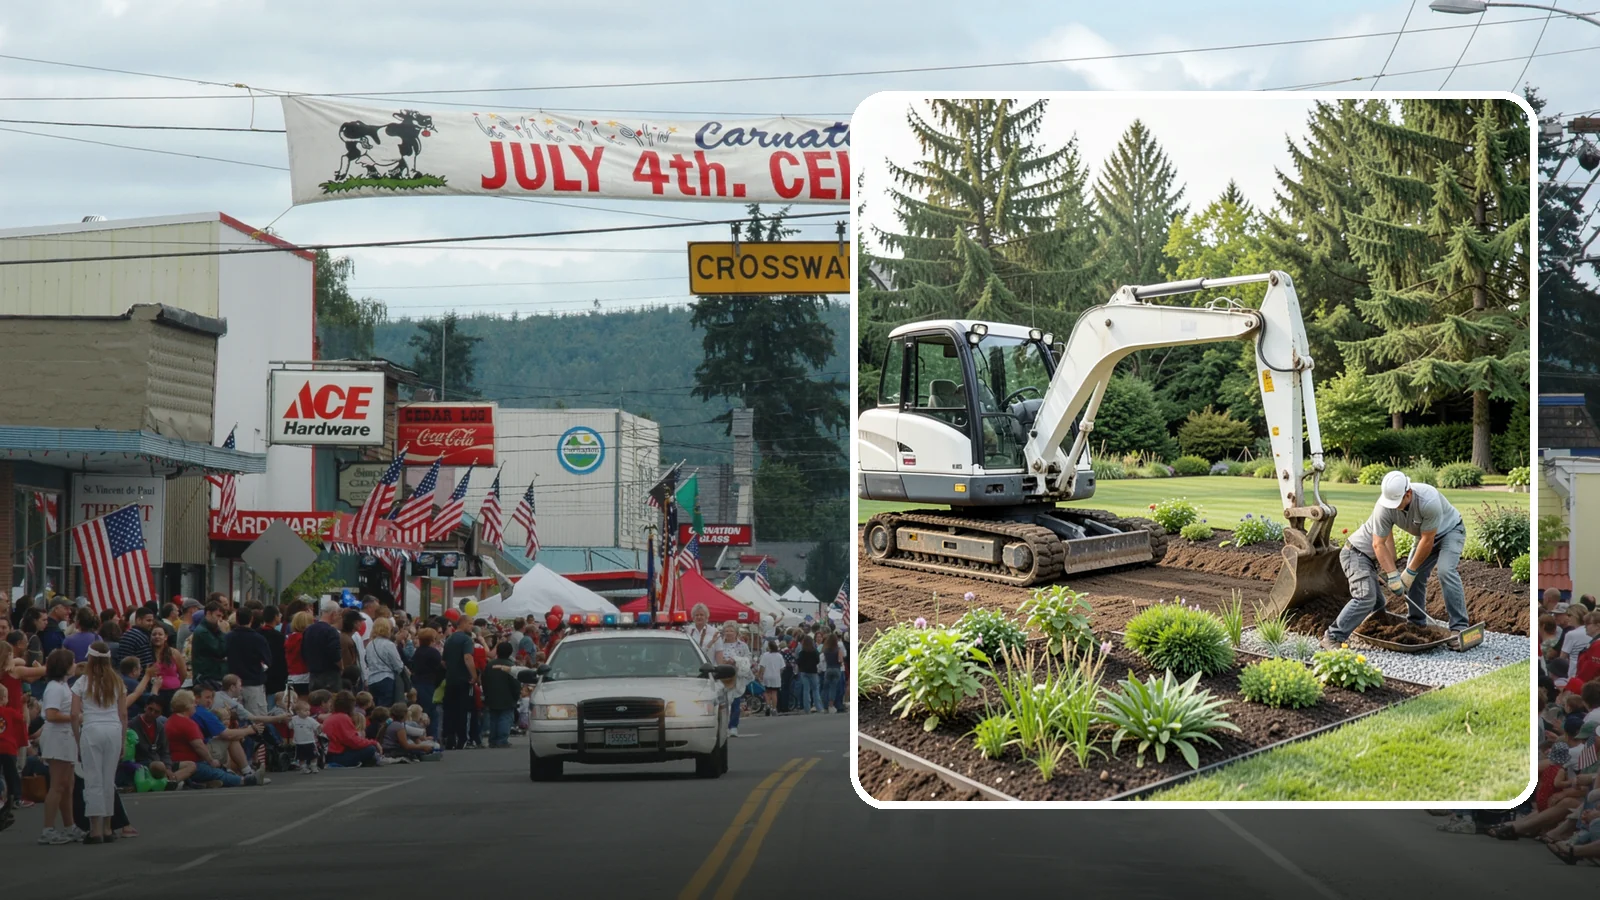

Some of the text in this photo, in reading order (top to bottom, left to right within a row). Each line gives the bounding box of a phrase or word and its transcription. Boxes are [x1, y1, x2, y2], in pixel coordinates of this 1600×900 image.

[481, 141, 605, 191] JULY
[632, 150, 746, 198] 4th.
[696, 254, 850, 280] CROSSWA
[282, 379, 374, 420] ACE
[405, 409, 485, 422] CEDAR LOG
[283, 421, 371, 436] Hardware
[416, 428, 477, 447] Coca-Cola
[353, 466, 387, 479] Simpl
[95, 485, 124, 495] Vincent
[126, 486, 136, 495] de
[137, 486, 155, 496] Paul
[212, 516, 330, 535] HARDARE
[688, 526, 741, 535] CRNATION
[700, 535, 730, 543] GLASS
